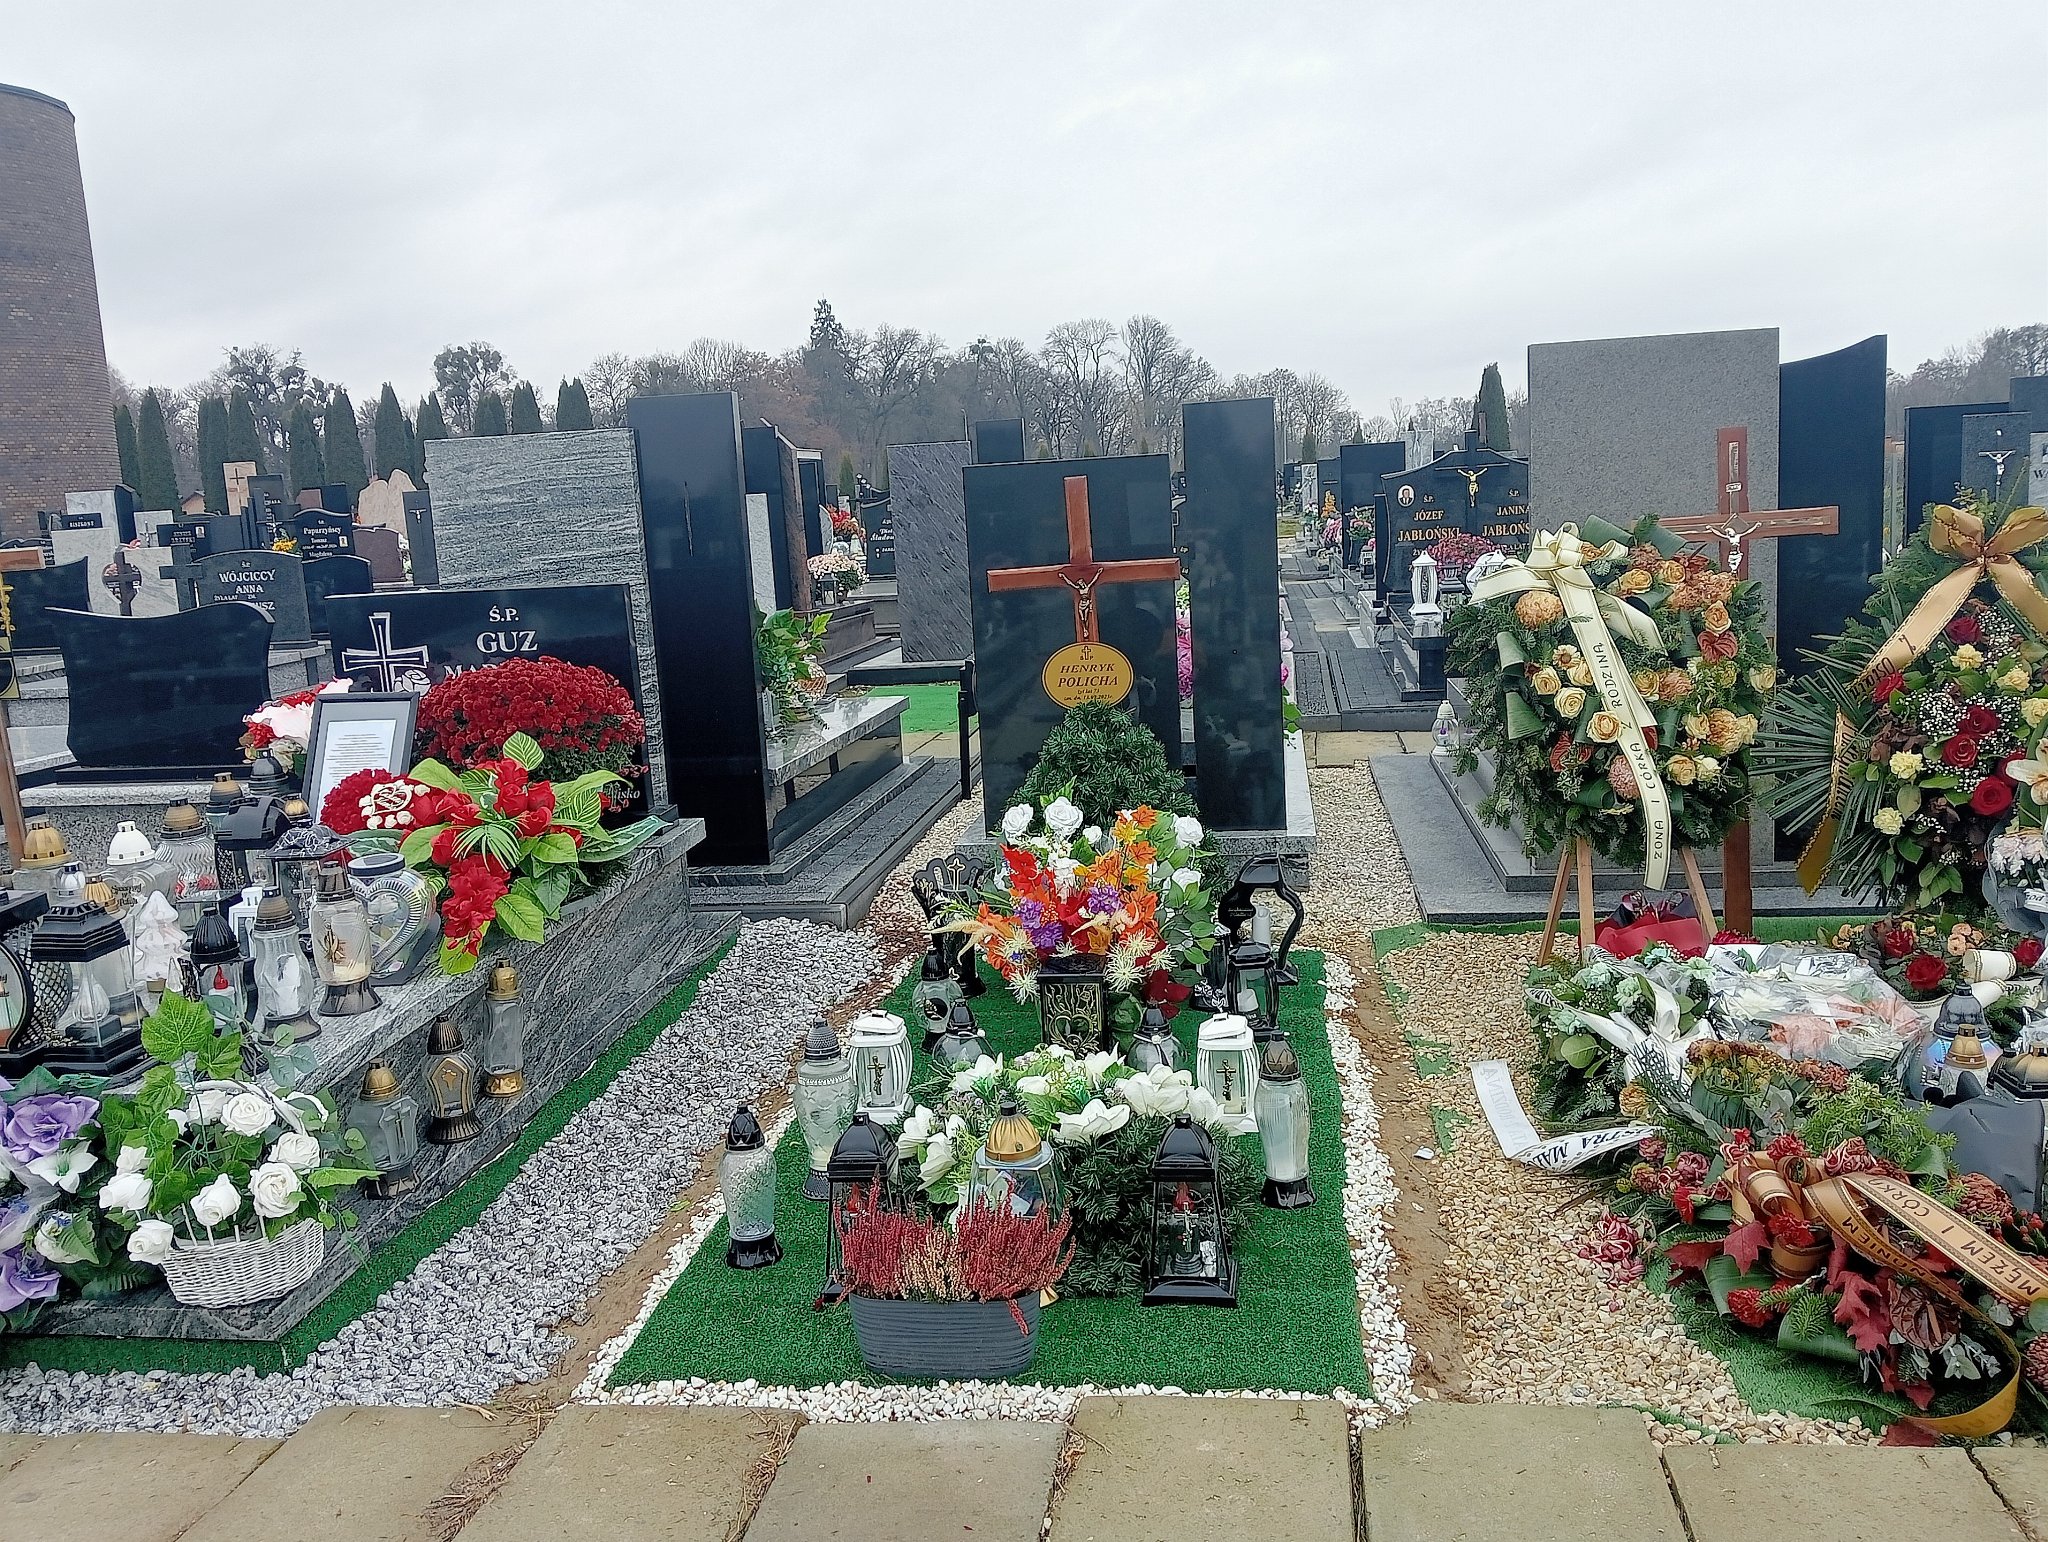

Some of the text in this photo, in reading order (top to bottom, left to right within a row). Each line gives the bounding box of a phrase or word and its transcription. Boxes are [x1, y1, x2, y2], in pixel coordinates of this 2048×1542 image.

[1413, 509, 1445, 521] JÓZEF
[1398, 525, 1461, 541] JABŁOŃSKI
[1482, 521, 1530, 538] JABŁOŃS
[219, 569, 276, 583] WÓJCICCY
[235, 584, 264, 594] ANNA
[489, 605, 520, 622] Ś.P.
[476, 630, 538, 653] GUZ
[1060, 664, 1115, 673] HENRYK
[1057, 675, 1118, 688] POLICHA
[1629, 742, 1656, 789] CÓRKA
